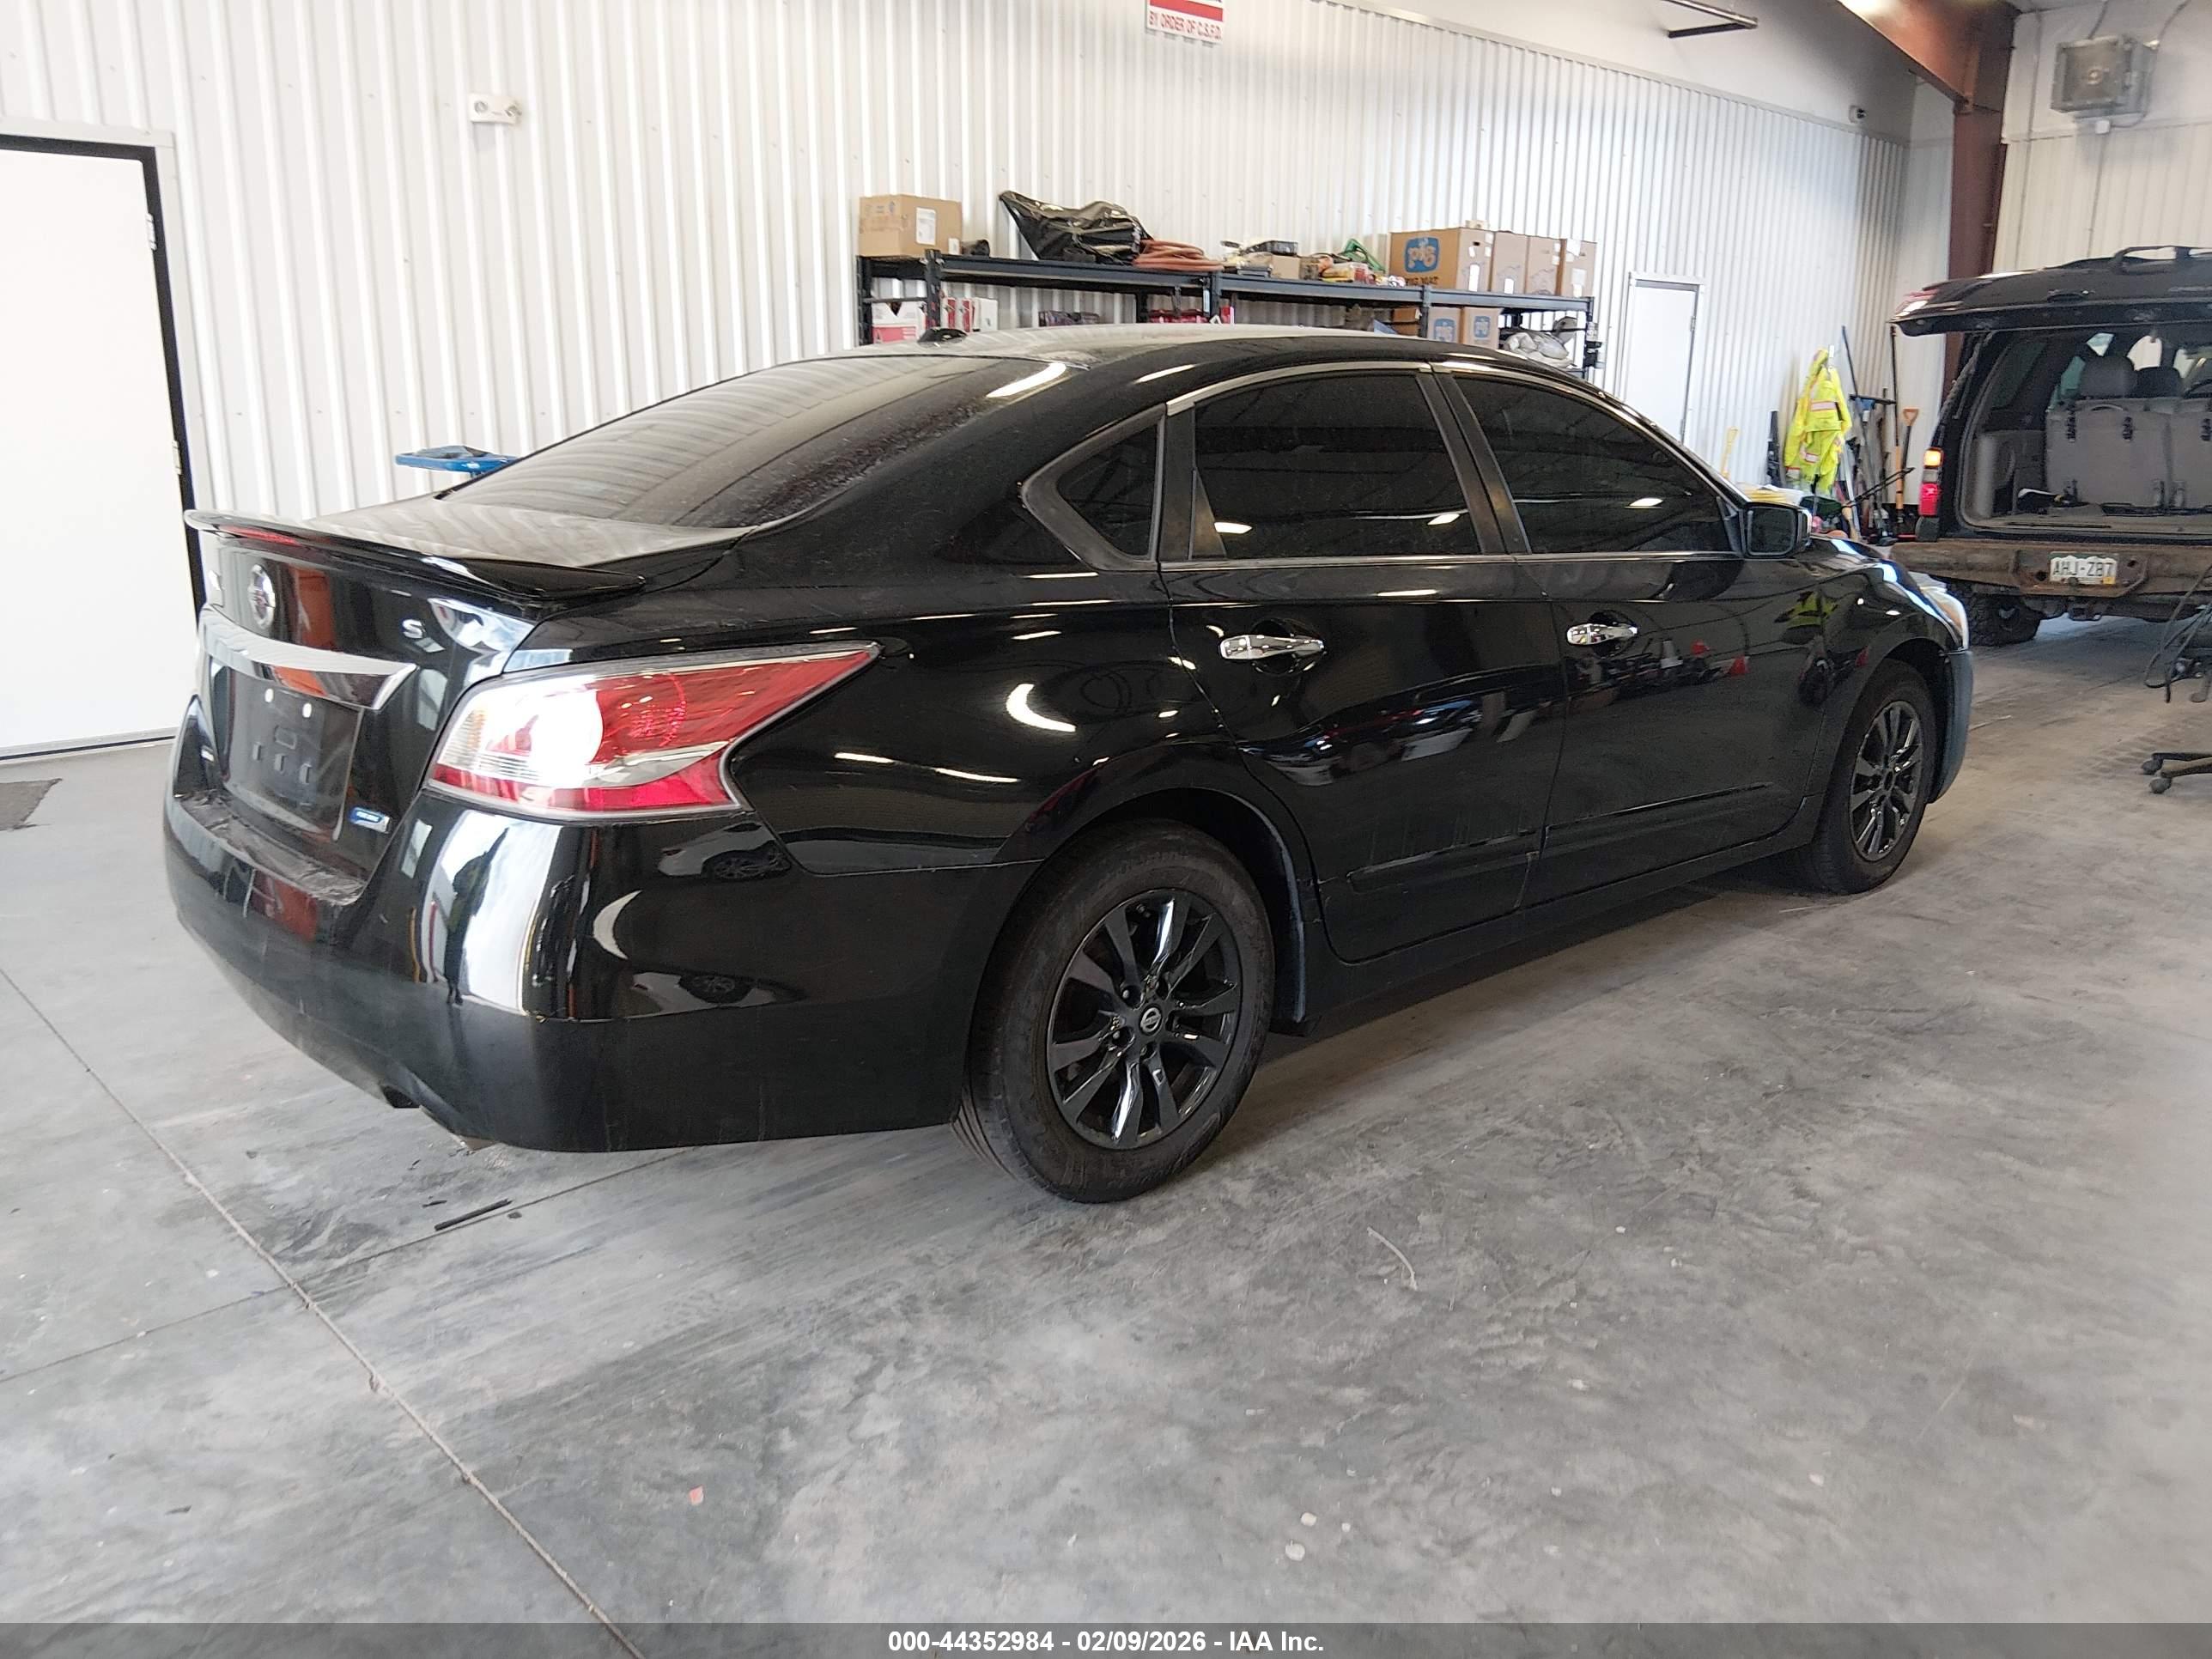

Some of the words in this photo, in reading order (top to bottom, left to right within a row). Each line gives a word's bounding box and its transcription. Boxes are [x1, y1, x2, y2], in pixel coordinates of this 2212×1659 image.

[1149, 10, 1158, 26] BY
[1161, 13, 1184, 32] ORDER
[402, 619, 423, 638] S
